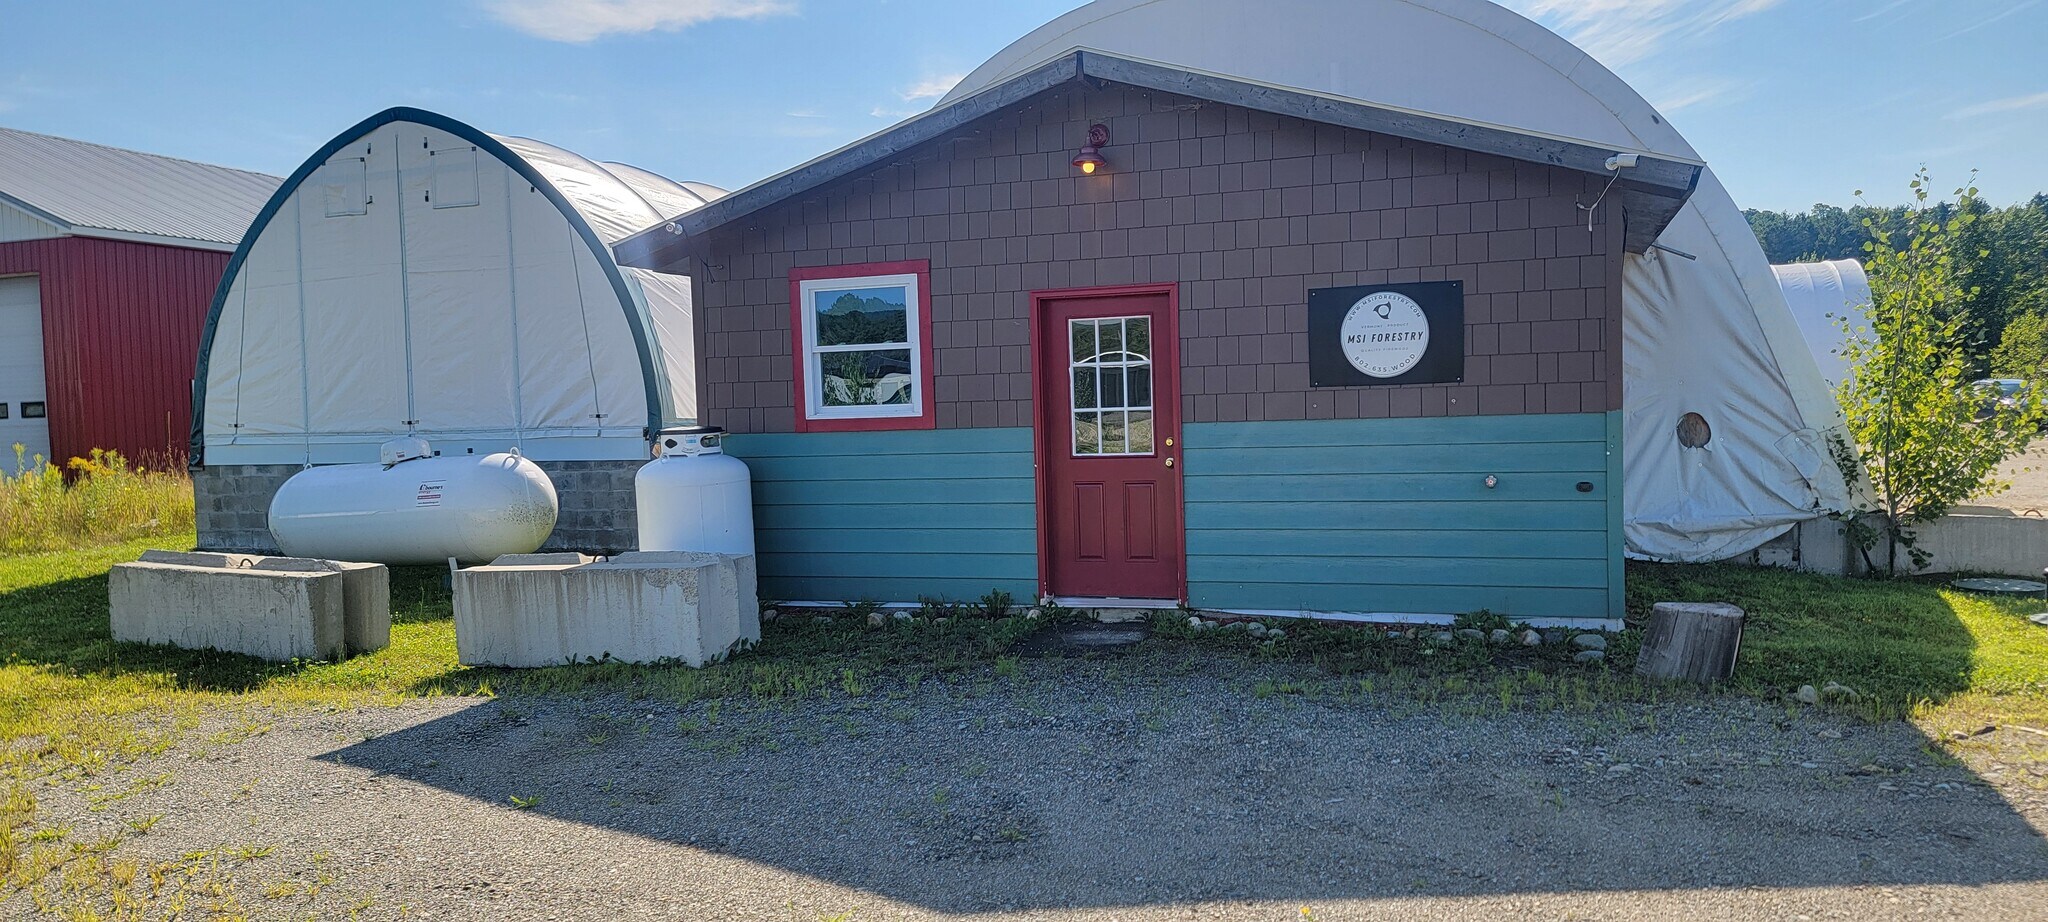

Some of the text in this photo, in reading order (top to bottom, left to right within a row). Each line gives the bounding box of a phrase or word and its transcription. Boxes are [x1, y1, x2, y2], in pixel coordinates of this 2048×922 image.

[1348, 295, 1421, 321] WWW.MSIFORESTRY.COM
[1347, 331, 1424, 344] MSI FORESTRY
[1354, 353, 1416, 373] 802.635.WOOD
